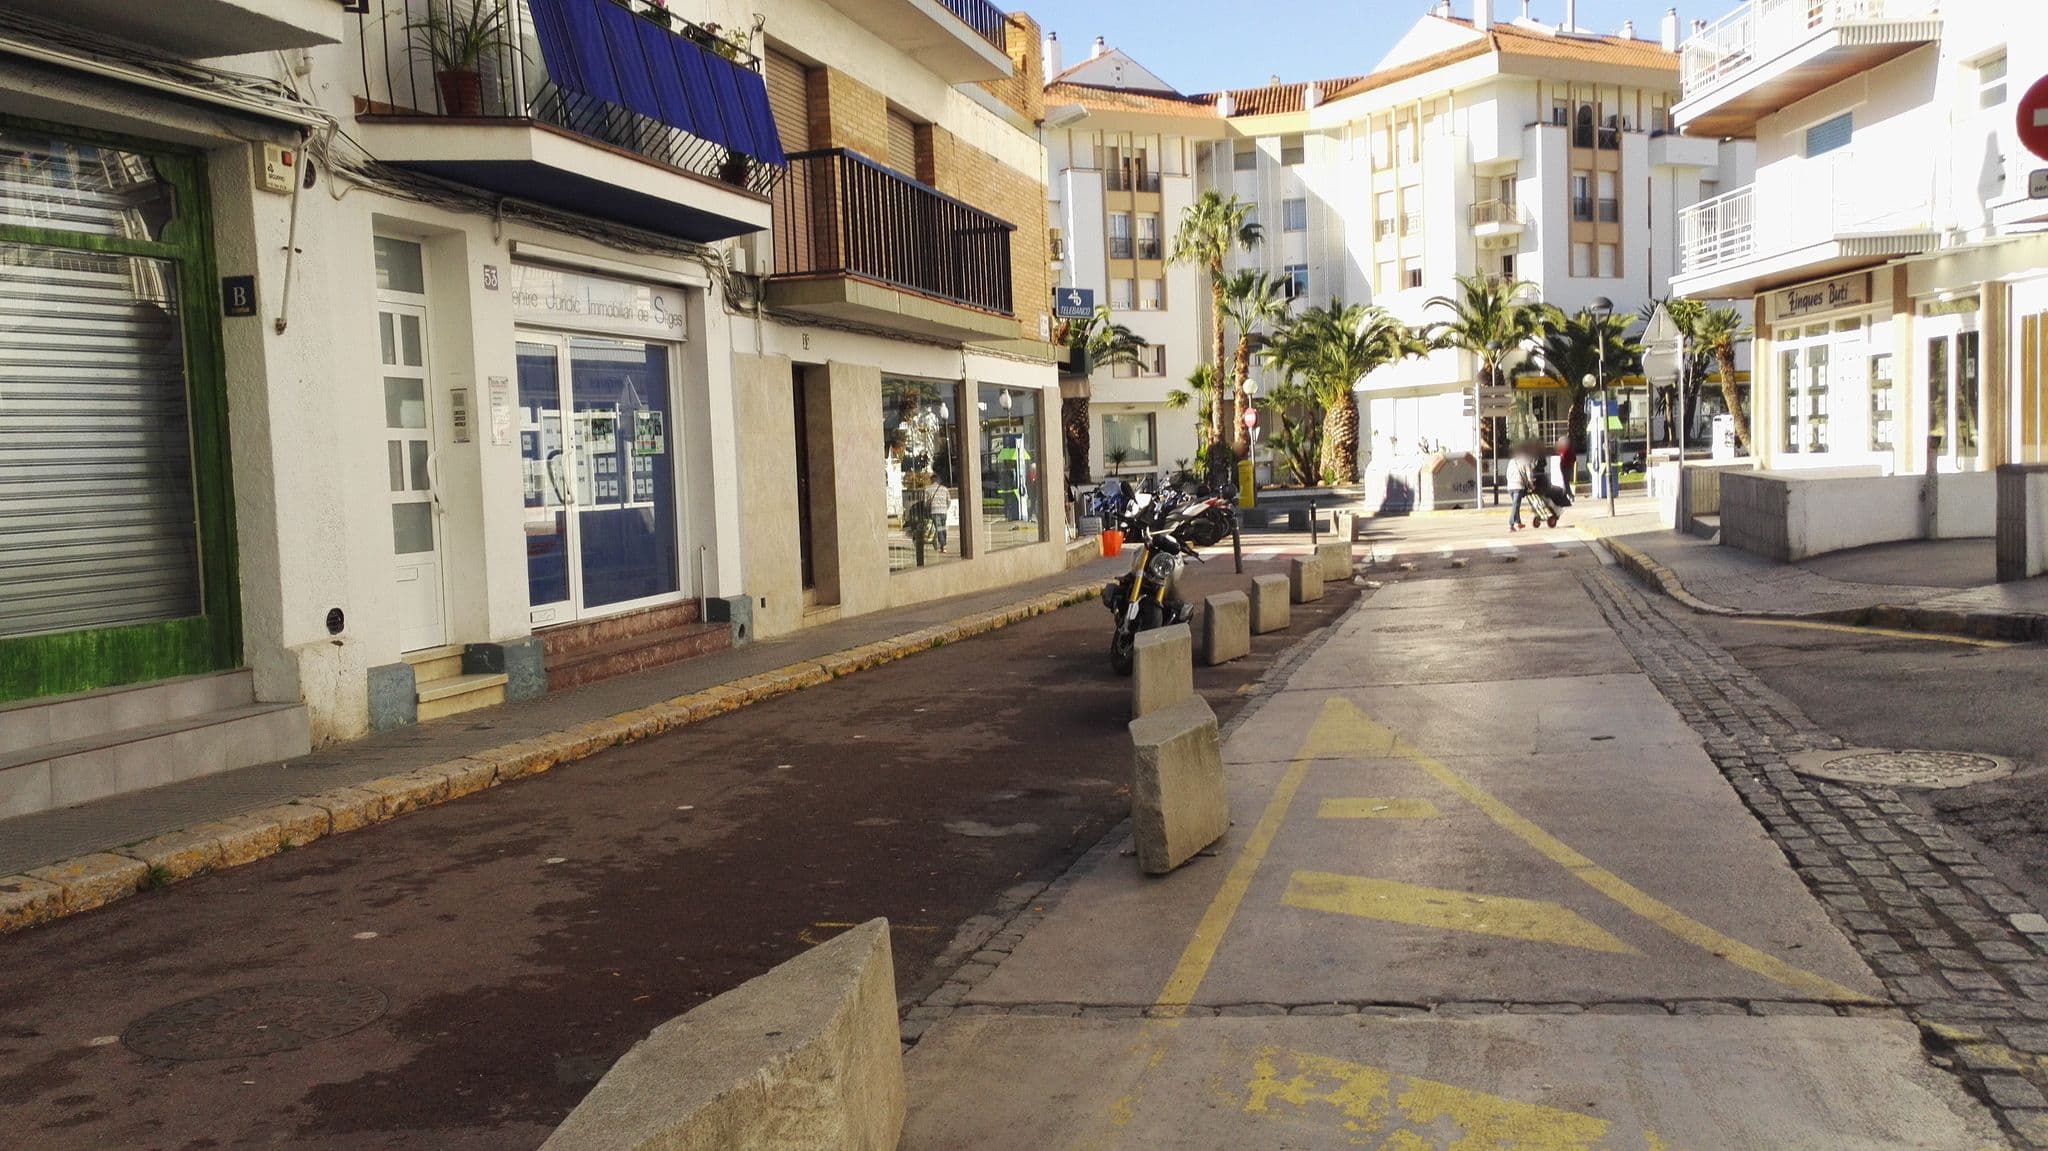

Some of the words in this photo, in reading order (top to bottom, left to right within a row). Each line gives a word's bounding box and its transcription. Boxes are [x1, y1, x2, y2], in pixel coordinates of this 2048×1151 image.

[485, 268, 498, 287] 53
[232, 287, 246, 306] B
[512, 290, 538, 308] entre
